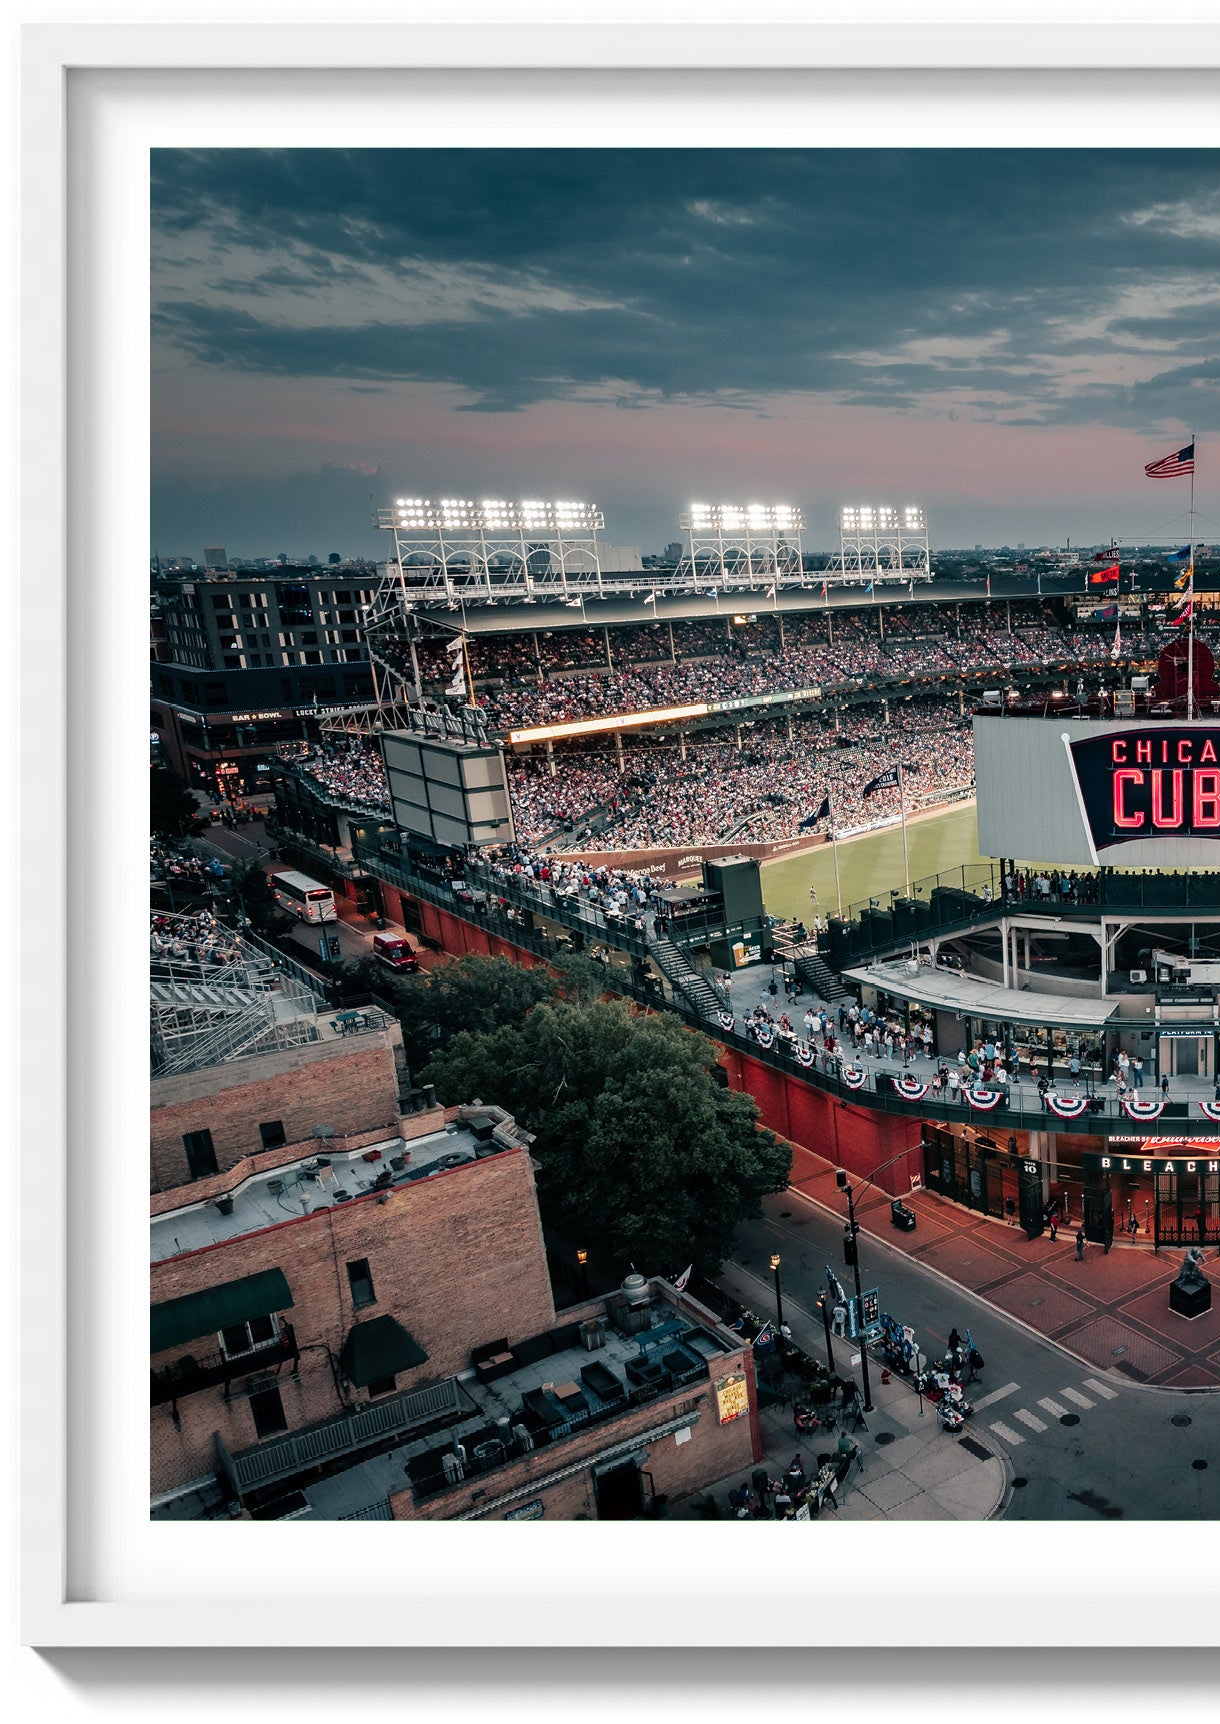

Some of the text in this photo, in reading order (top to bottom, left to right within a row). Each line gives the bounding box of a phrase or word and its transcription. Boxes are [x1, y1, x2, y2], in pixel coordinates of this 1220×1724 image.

[232, 712, 282, 722] BAR BOWL
[295, 708, 318, 717] LUCKY
[678, 855, 704, 867] MARQUEE
[650, 862, 666, 873] Beef
[1023, 1164, 1037, 1174] 10
